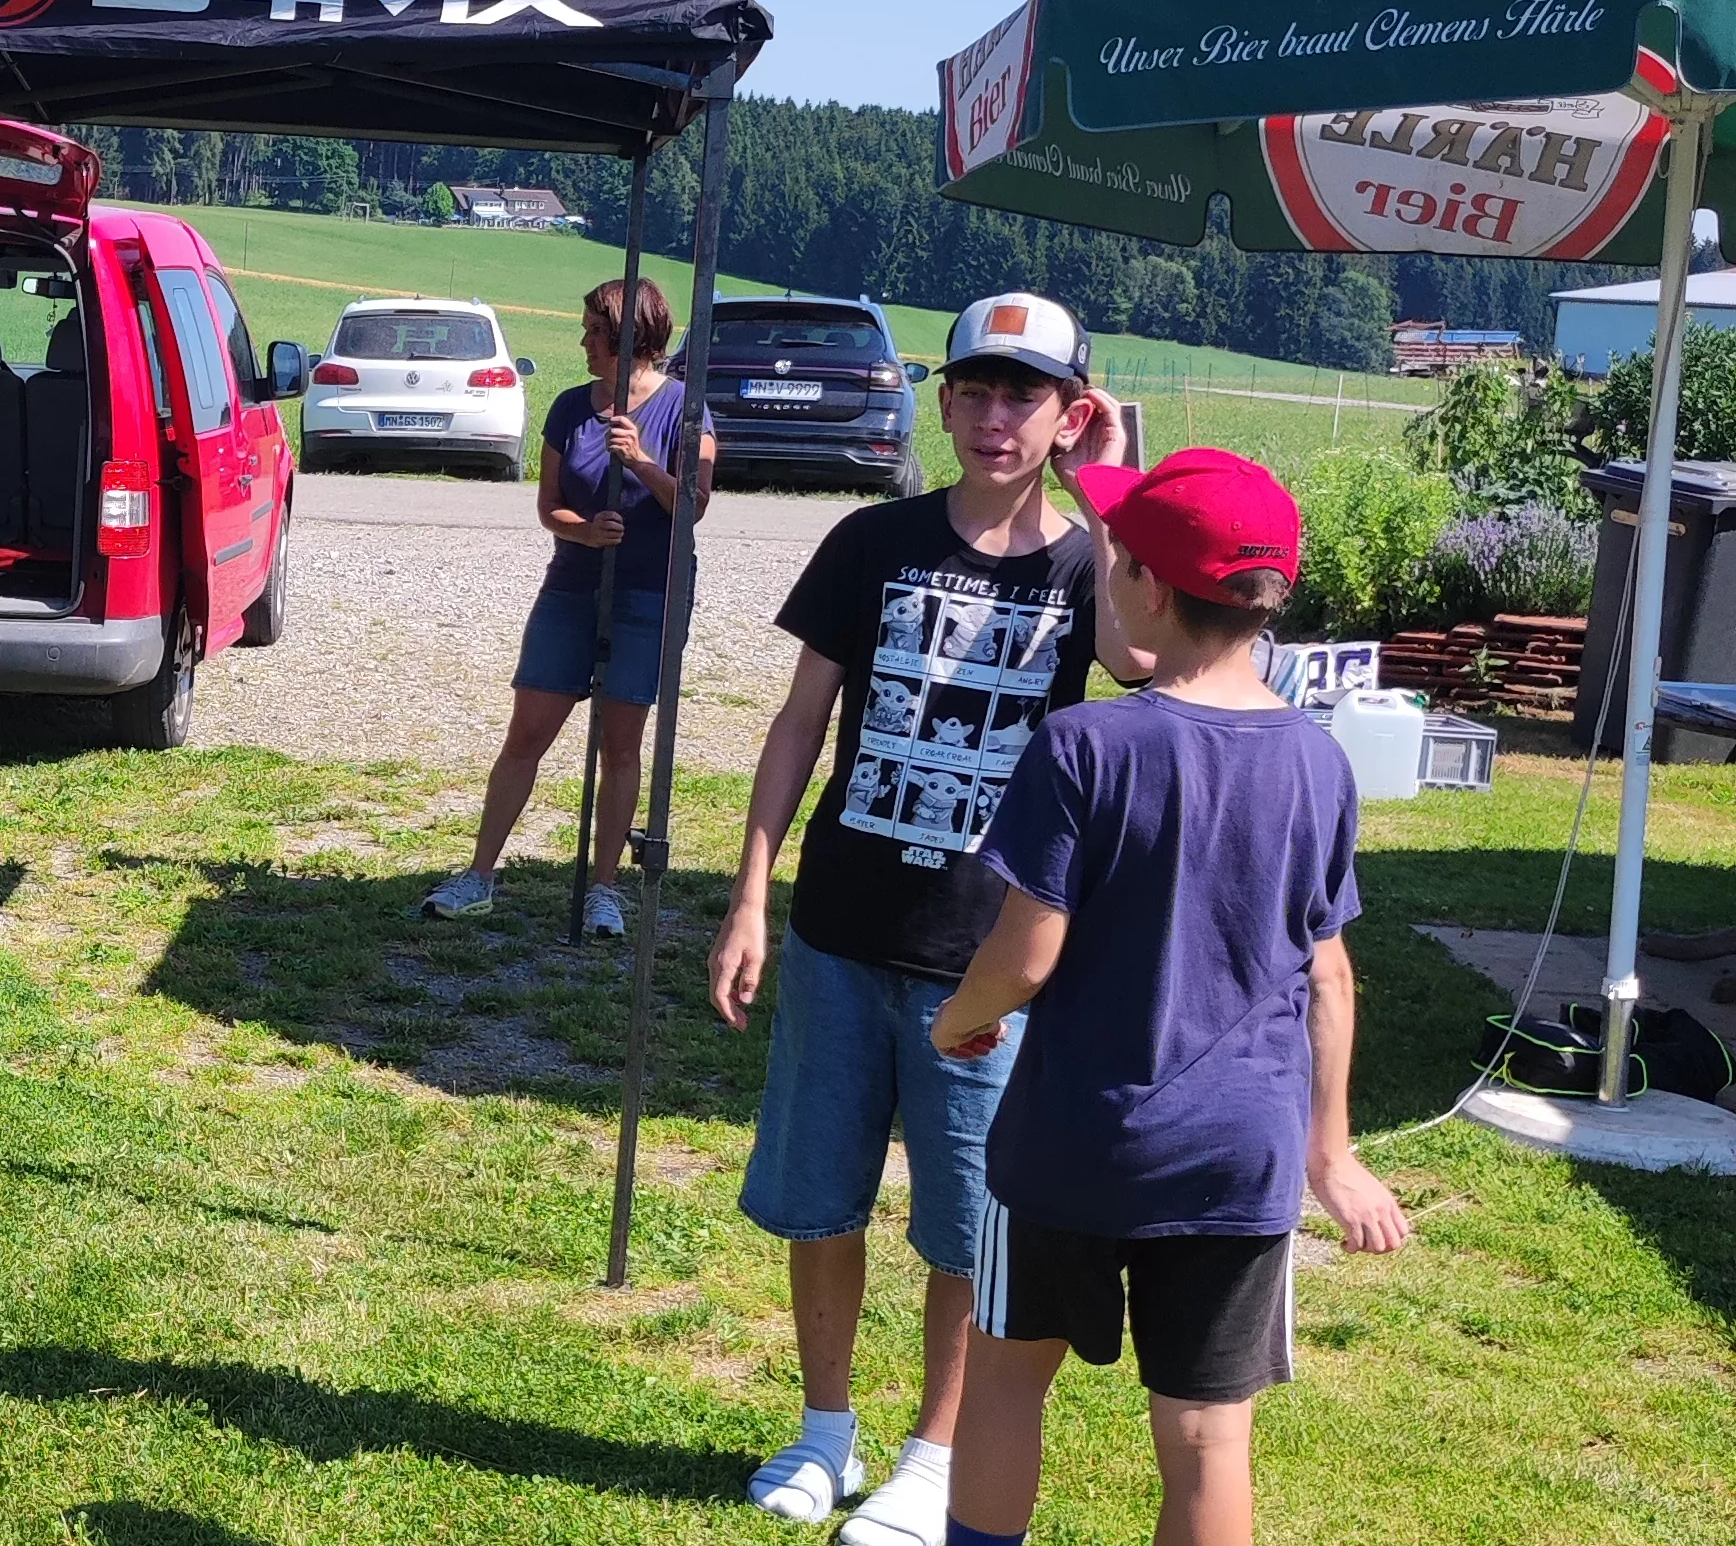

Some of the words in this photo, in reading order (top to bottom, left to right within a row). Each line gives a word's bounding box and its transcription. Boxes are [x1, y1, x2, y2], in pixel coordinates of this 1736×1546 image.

[1099, 37, 1184, 75] Unser
[1192, 25, 1268, 64] Bier
[1277, 21, 1359, 57] braut
[1364, 8, 1489, 51] Clemens
[967, 64, 1012, 155] Bier
[750, 381, 767, 394] MN
[385, 414, 398, 427] MN
[404, 415, 417, 427] GS
[419, 415, 443, 428] 1502
[897, 565, 1002, 598] SOMETIMES
[1009, 585, 1020, 600] I
[1027, 587, 1068, 606] FEEL
[1017, 676, 1046, 687] ANGRY
